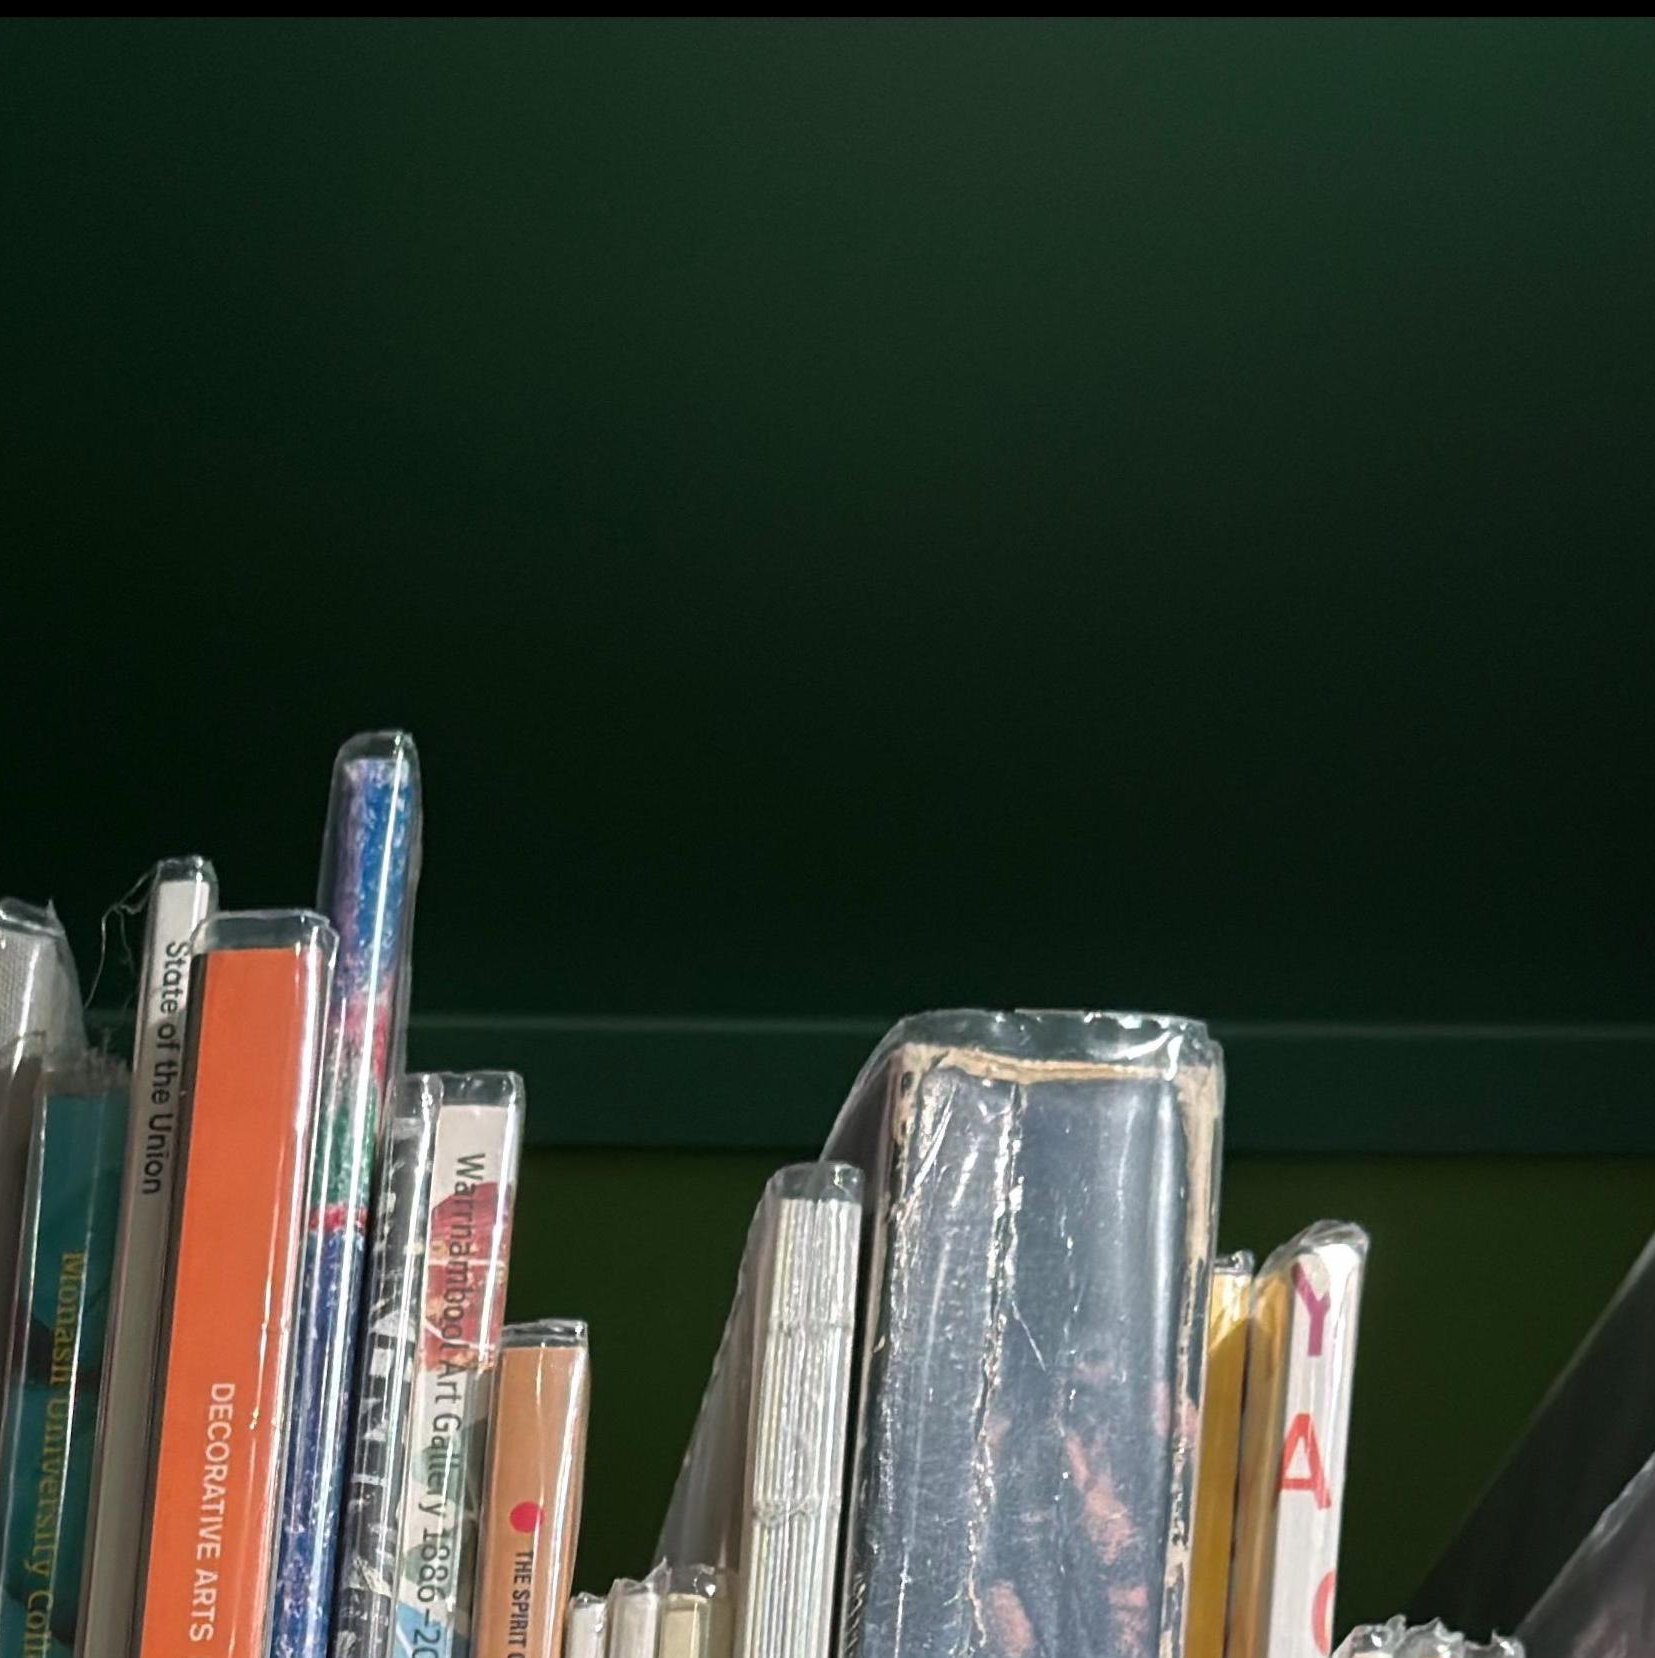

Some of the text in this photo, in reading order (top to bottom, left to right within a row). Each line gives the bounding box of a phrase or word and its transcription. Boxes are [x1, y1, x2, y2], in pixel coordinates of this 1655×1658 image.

[141, 941, 190, 1195] State the Union
[48, 1250, 87, 1382] Monash
[415, 1153, 488, 1516] Warrnambool Art Gallery
[193, 1382, 238, 1560] DECORATIVE
[185, 1569, 221, 1640] ARTS
[505, 1589, 532, 1647] SPIRIT
[510, 1550, 535, 1583] THE
